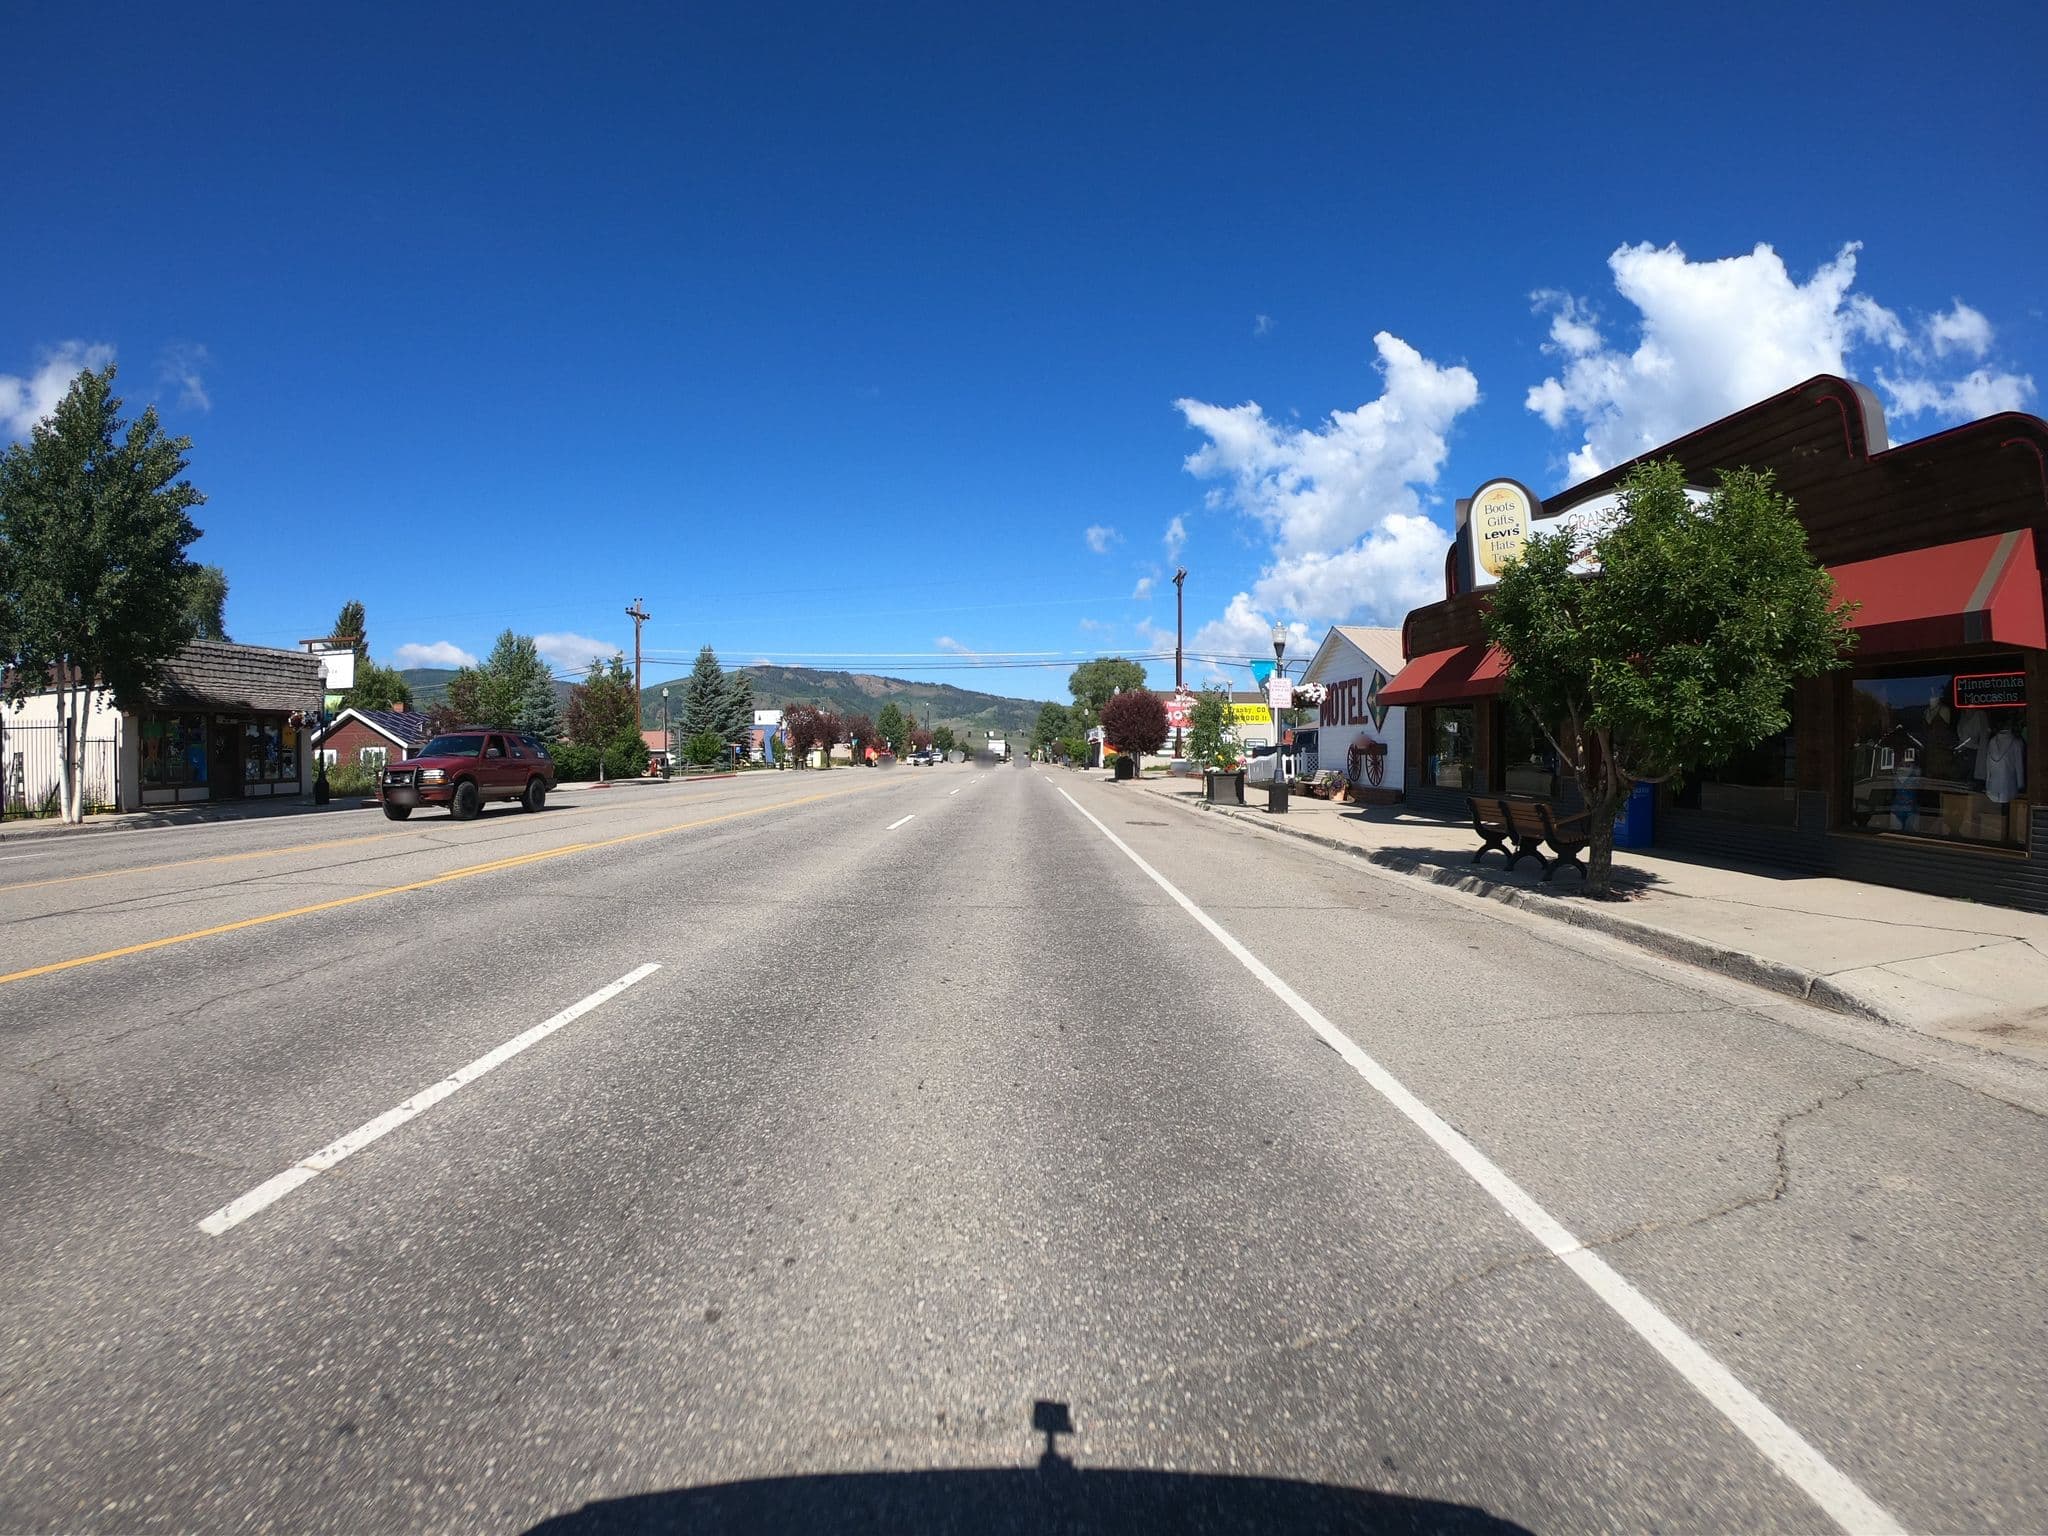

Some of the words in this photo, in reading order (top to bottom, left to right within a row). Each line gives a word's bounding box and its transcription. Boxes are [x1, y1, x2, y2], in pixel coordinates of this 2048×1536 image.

[1485, 502, 1515, 515] Boots
[1488, 515, 1515, 527] Gifts
[1491, 541, 1516, 552] Hats
[1957, 676, 2024, 691] Minnetonka
[1320, 677, 1368, 727] MOTEL
[1964, 692, 2018, 704] Moccasins
